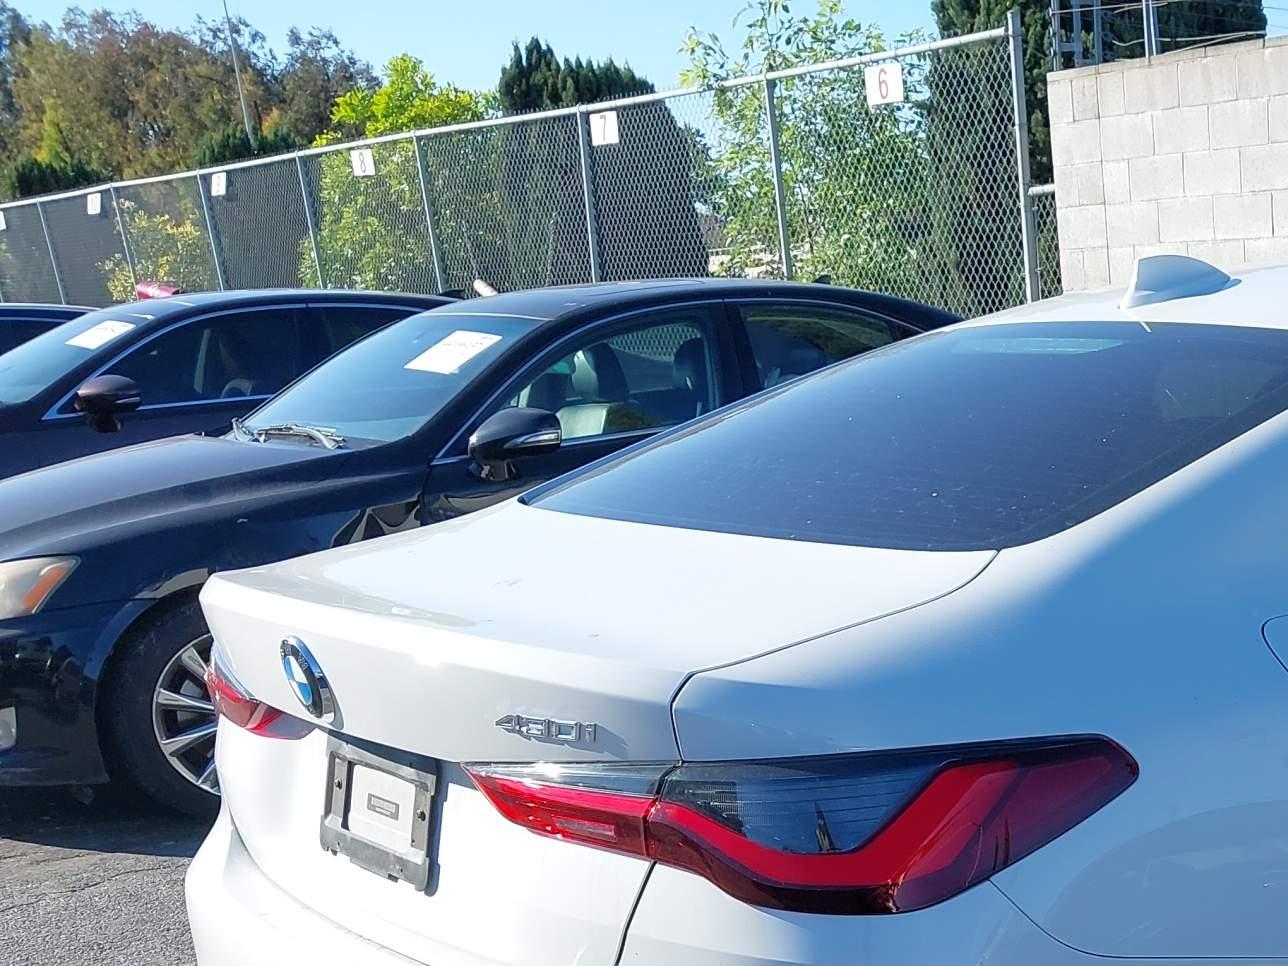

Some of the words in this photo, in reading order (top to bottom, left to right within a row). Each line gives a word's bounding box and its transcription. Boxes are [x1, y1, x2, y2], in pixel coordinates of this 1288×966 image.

[878, 67, 889, 100] 6
[599, 114, 607, 142] 7
[358, 150, 367, 174] 8
